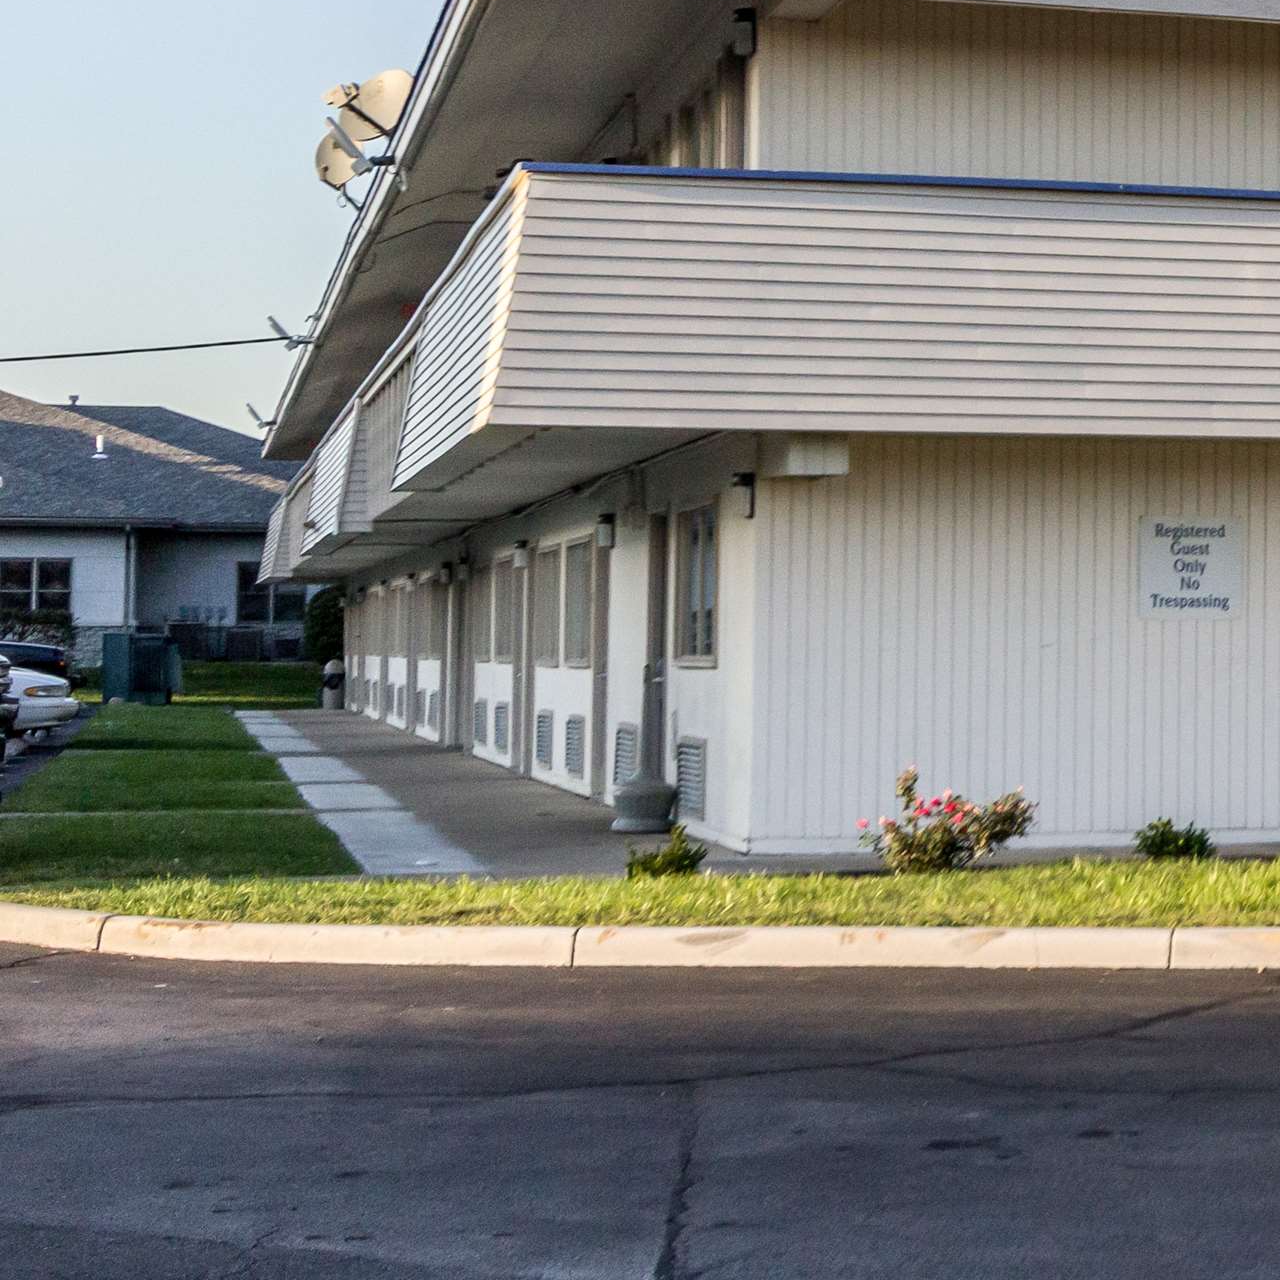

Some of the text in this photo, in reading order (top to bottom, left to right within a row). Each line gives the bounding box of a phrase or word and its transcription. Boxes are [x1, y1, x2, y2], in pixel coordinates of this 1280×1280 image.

[1155, 523, 1226, 540] Registered
[1170, 541, 1210, 556] Guest
[1173, 558, 1207, 576] Only
[1179, 577, 1201, 591] No
[1150, 593, 1230, 611] Trespassing
